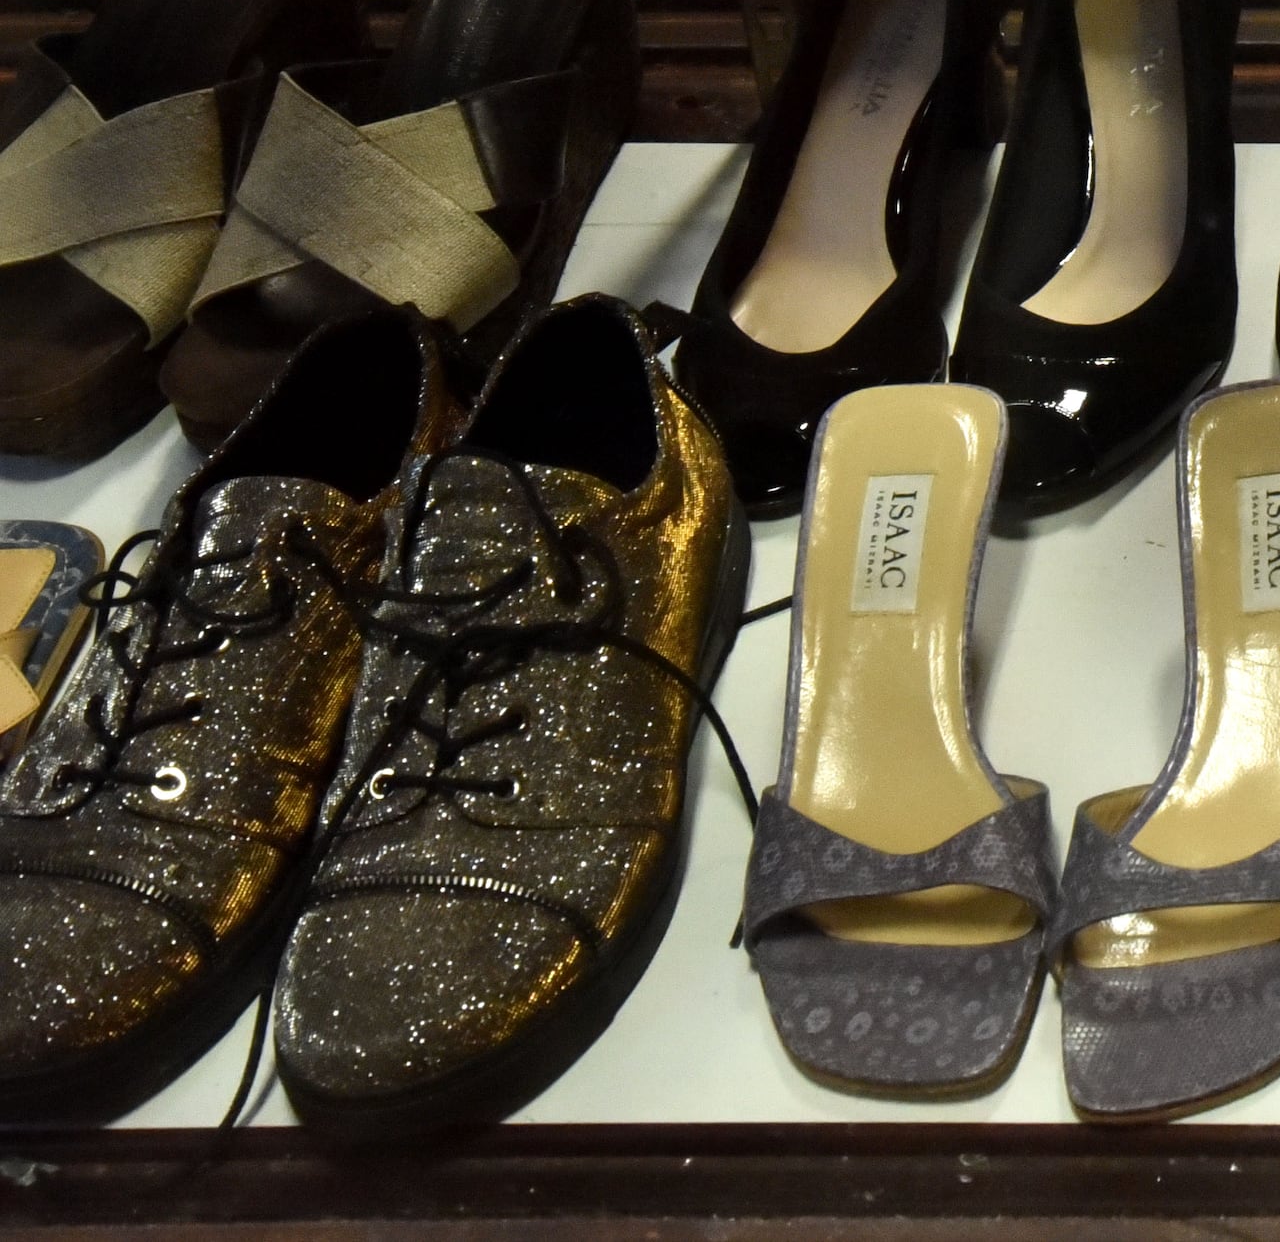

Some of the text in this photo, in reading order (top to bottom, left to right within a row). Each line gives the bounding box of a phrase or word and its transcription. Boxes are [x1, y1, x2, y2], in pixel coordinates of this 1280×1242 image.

[872, 490, 884, 528] ISAAC
[880, 490, 918, 588] ISAAC
[1251, 490, 1261, 590] ISAAC MIZRAHI
